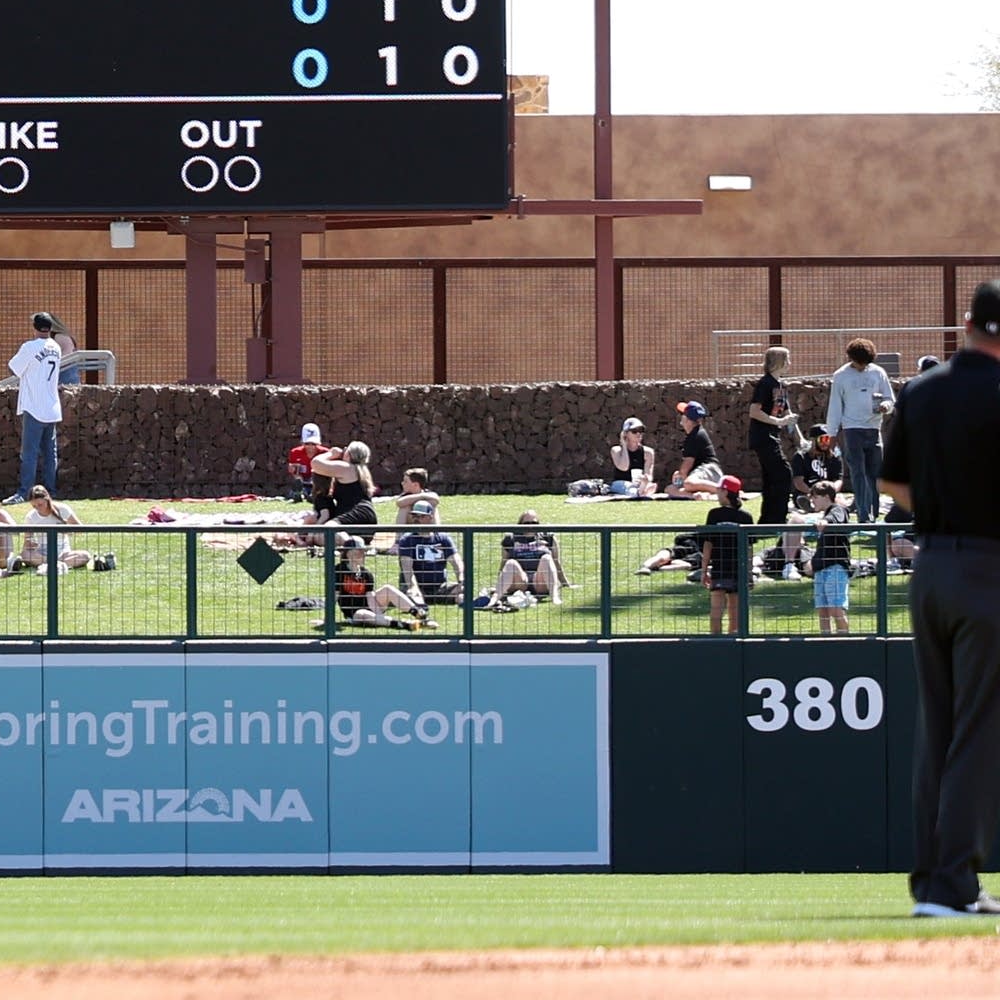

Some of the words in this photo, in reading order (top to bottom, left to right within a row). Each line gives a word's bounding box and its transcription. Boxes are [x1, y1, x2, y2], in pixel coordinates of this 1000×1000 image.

[292, 48, 329, 88] 0
[378, 46, 398, 85] 1
[443, 45, 479, 85] 0
[181, 120, 262, 148] OUT
[47, 360, 56, 381] 7
[747, 676, 884, 732] 380
[61, 787, 313, 822] ARIZONA
